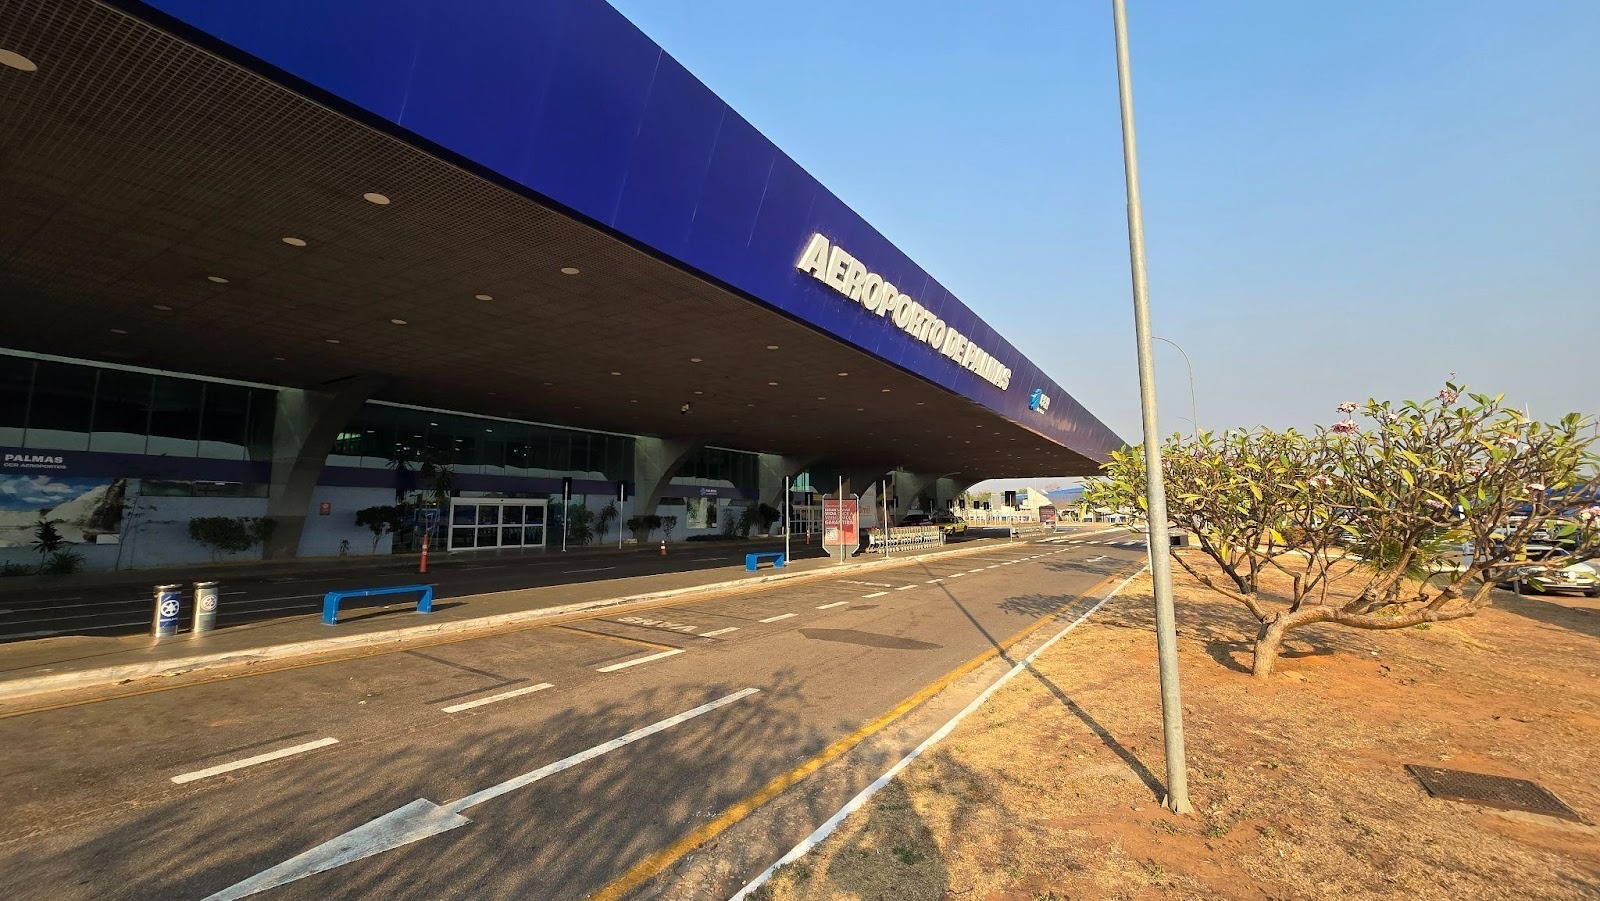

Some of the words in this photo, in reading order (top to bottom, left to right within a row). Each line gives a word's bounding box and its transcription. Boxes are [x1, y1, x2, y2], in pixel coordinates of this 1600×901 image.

[797, 233, 946, 349] AEROPORTO
[941, 327, 969, 366] DE
[962, 341, 1012, 391] PALMAS
[4, 454, 64, 464] PALMAS
